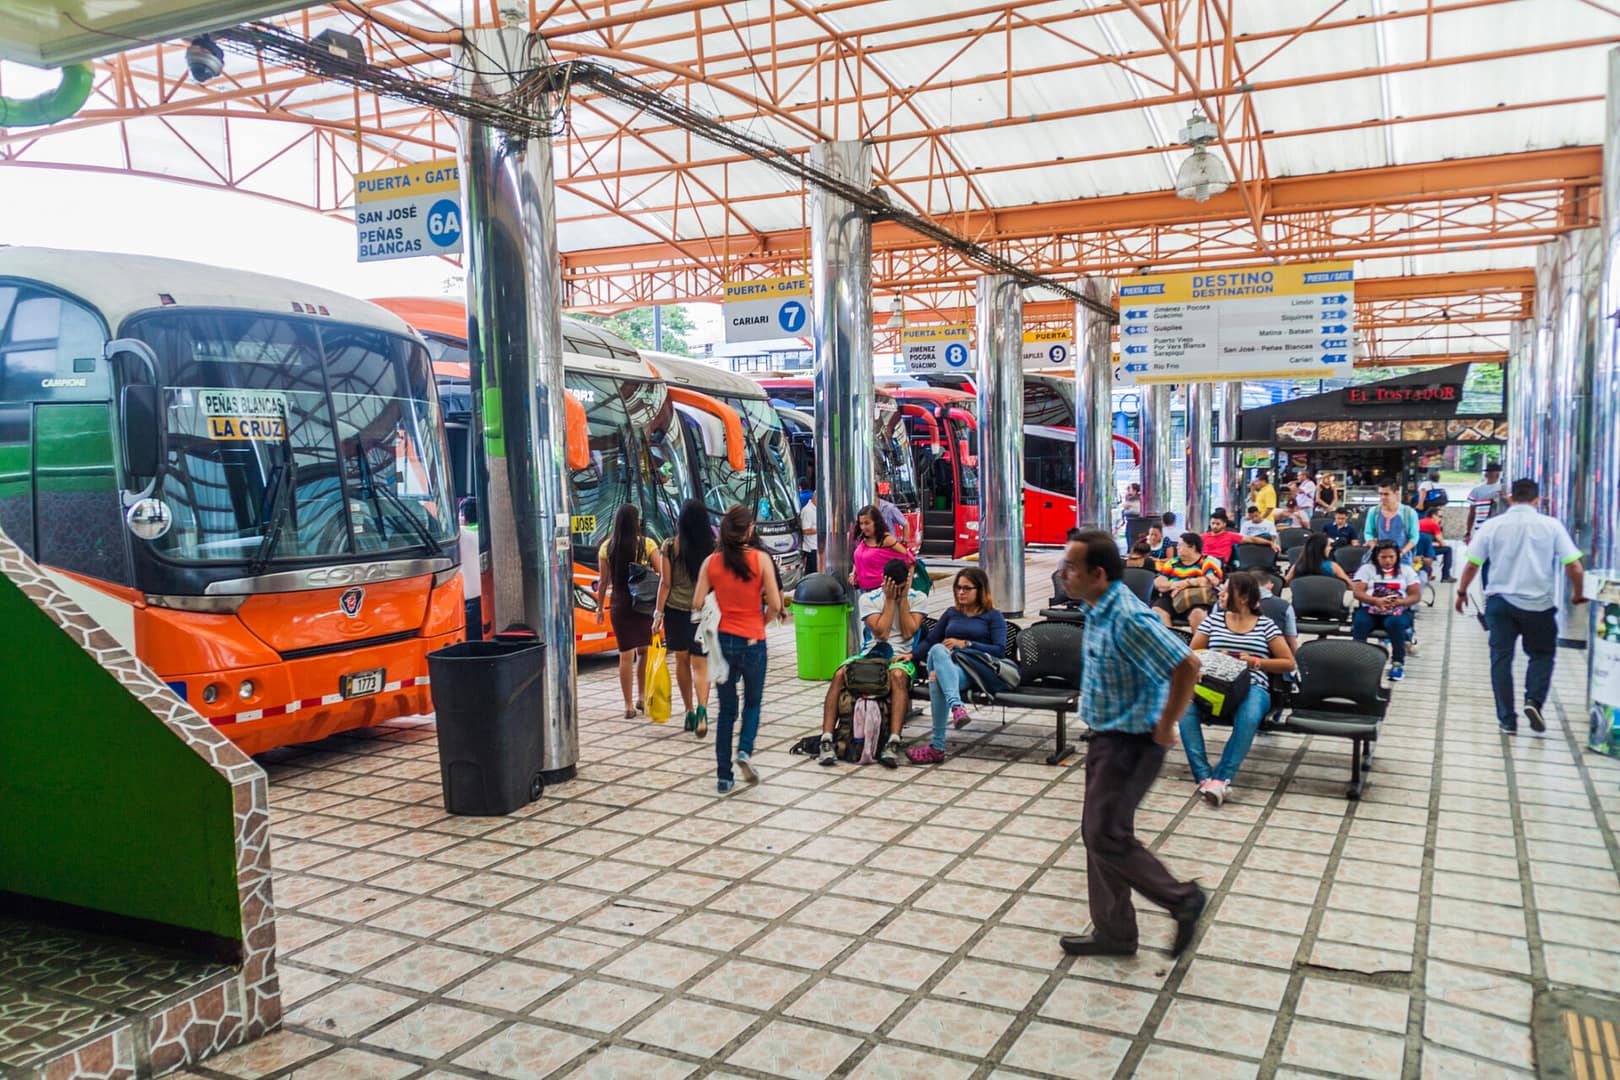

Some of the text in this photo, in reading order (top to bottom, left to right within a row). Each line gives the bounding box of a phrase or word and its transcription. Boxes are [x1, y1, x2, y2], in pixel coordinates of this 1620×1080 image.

[358, 167, 459, 192] PUERTA GATE
[358, 204, 417, 224] SAN JOSÉ
[429, 211, 460, 235] 6A
[360, 227, 403, 243] PEÑAS
[360, 239, 422, 257] BLANCAS
[1192, 271, 1274, 288] DESTINO
[727, 280, 805, 296] PUERTA GATE
[1192, 286, 1274, 298] DESTINATION
[732, 316, 769, 326] CARIARI
[784, 306, 799, 328] 7
[950, 347, 962, 362] 8
[1052, 348, 1062, 361] 9
[1376, 386, 1456, 400] TOSTADOR
[206, 392, 284, 414] PEÑAS BLANCAS
[212, 420, 284, 437] LA CRUZ
[575, 517, 594, 531] JOSE
[359, 677, 376, 691] 1773
